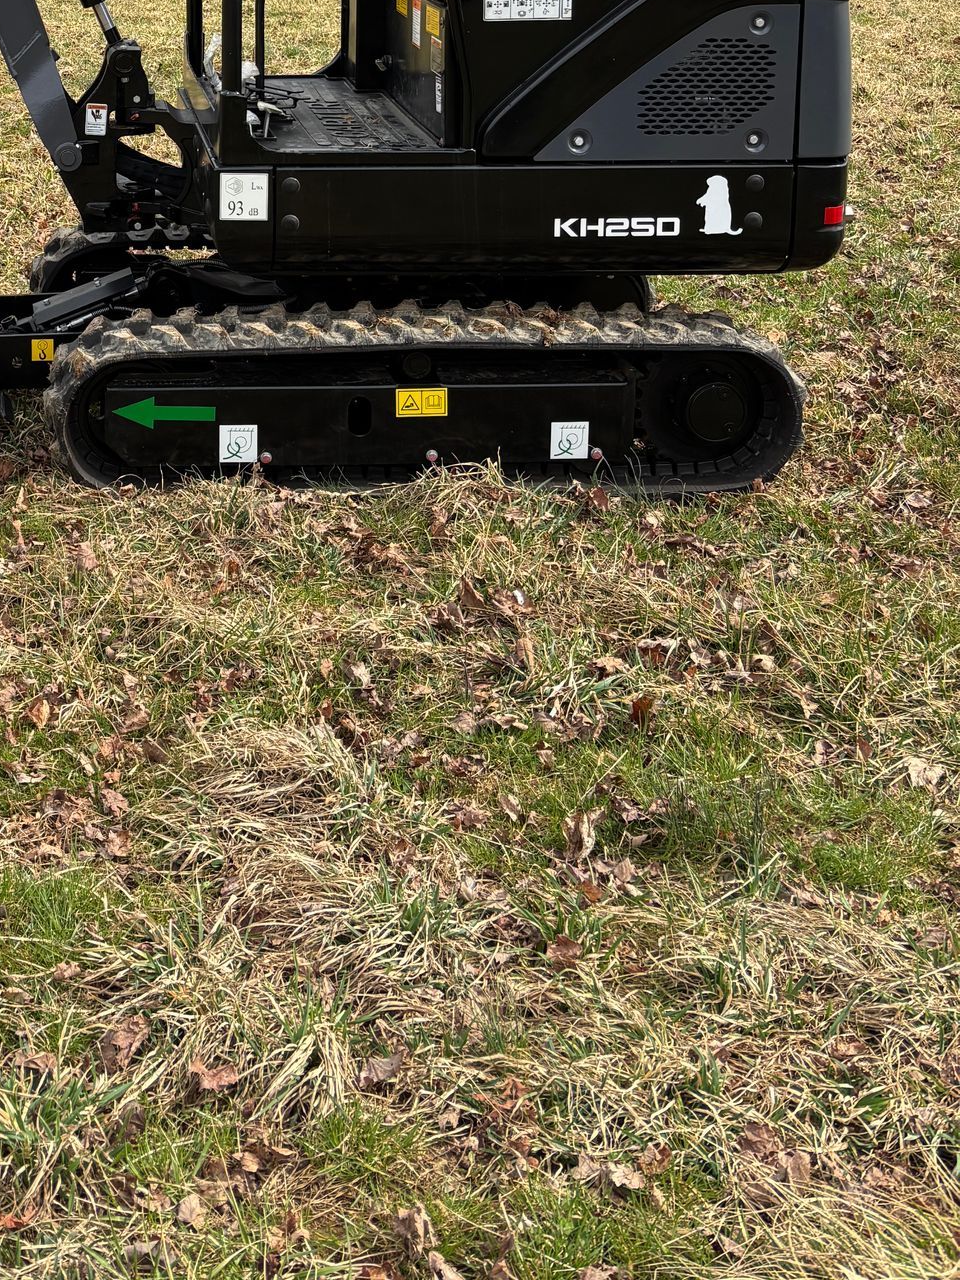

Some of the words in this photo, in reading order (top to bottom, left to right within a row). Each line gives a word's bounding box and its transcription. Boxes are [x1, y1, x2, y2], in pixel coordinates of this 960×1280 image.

[227, 200, 244, 216] 93
[248, 207, 259, 216] dB
[554, 217, 680, 237] KH250
